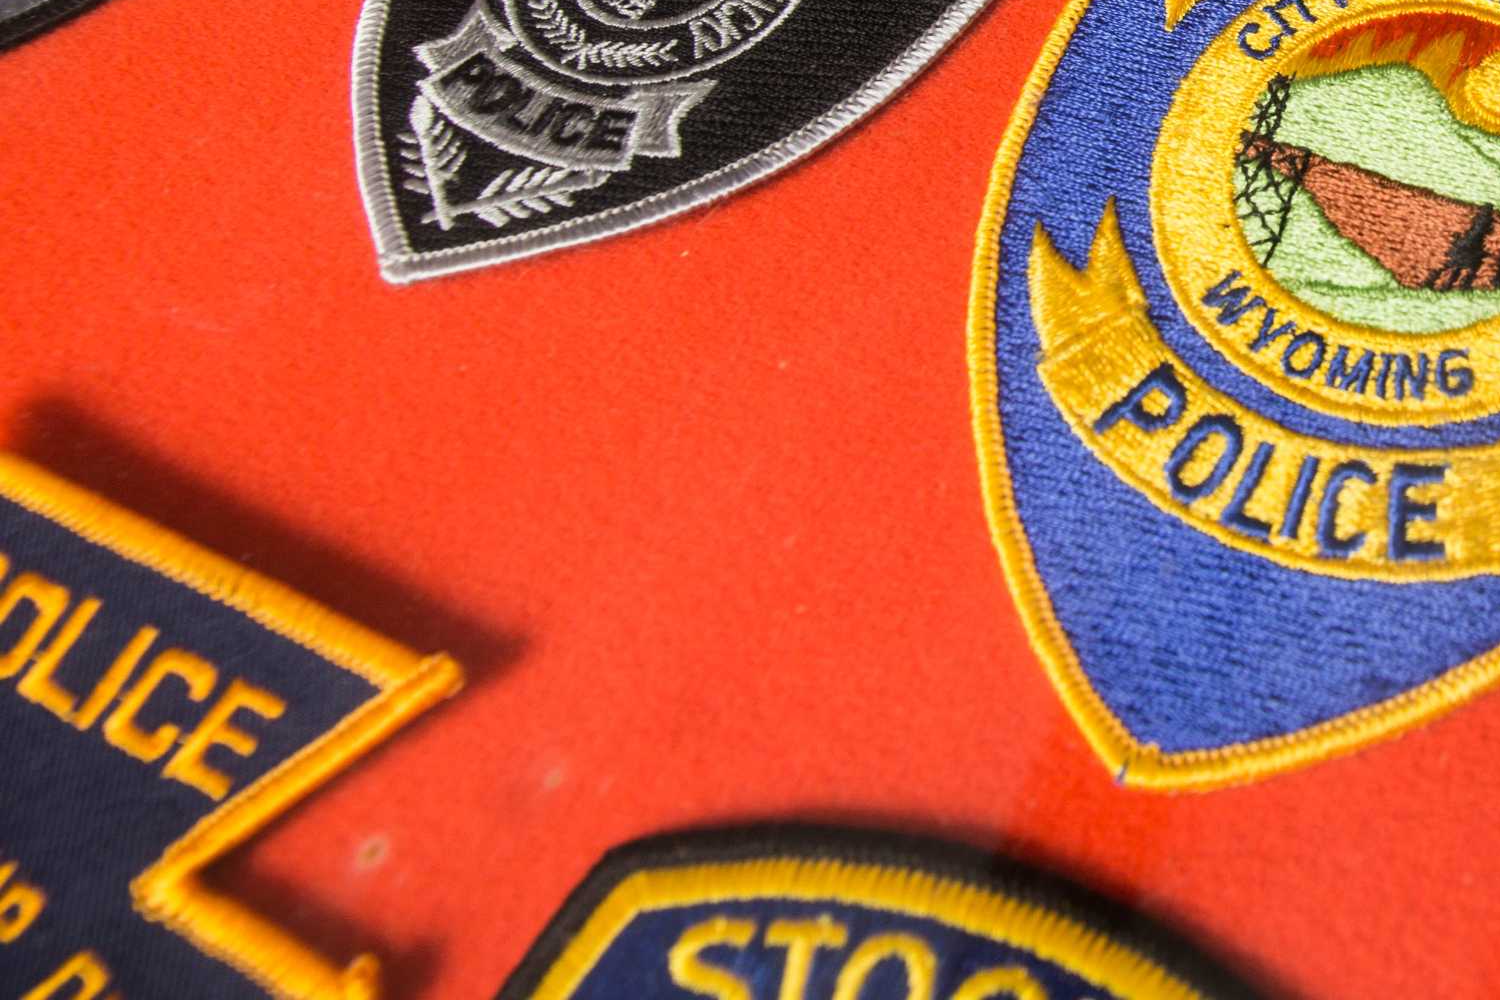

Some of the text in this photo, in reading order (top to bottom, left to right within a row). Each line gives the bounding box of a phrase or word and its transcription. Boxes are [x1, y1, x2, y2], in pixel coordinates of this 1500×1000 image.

[439, 54, 639, 150] POLICE
[1200, 269, 1477, 402] WYOMING
[1093, 362, 1453, 561] POLICE
[0, 553, 288, 802] OLICE
